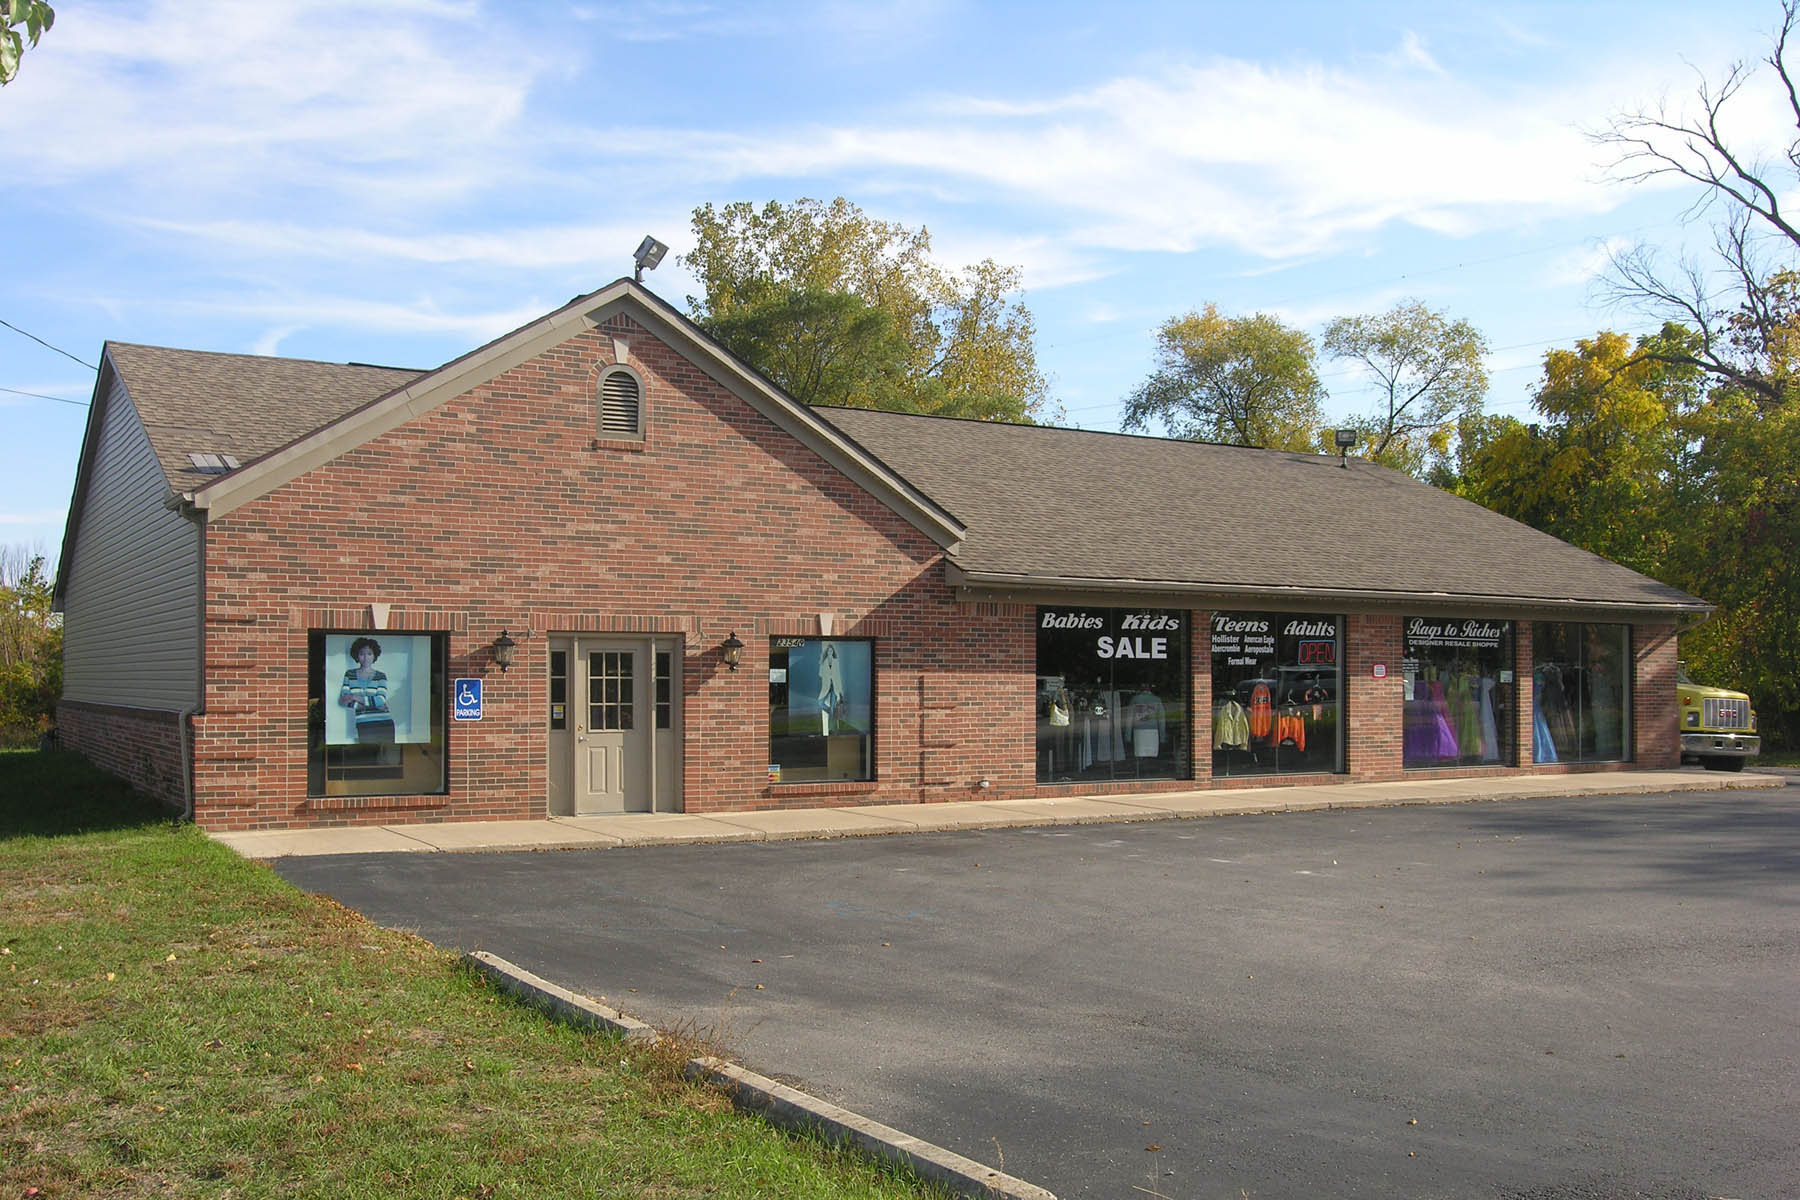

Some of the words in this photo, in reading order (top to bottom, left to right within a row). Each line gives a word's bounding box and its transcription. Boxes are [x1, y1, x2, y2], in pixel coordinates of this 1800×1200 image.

[1041, 613, 1104, 629] Babies
[1121, 614, 1180, 631] Kids
[1215, 616, 1269, 632] Teens
[1283, 620, 1336, 637] Adults
[1407, 618, 1441, 640] Rags
[1444, 623, 1458, 636] to
[1460, 620, 1500, 638] Riches
[1211, 634, 1240, 643] Hollister
[1244, 634, 1263, 643] American
[1408, 639, 1443, 647] DESIGNER
[1097, 636, 1168, 659] SALE
[1300, 642, 1335, 664] OPEN
[1227, 657, 1245, 666] Formal
[1244, 657, 1257, 665] Wear
[456, 709, 480, 717] PARKING
